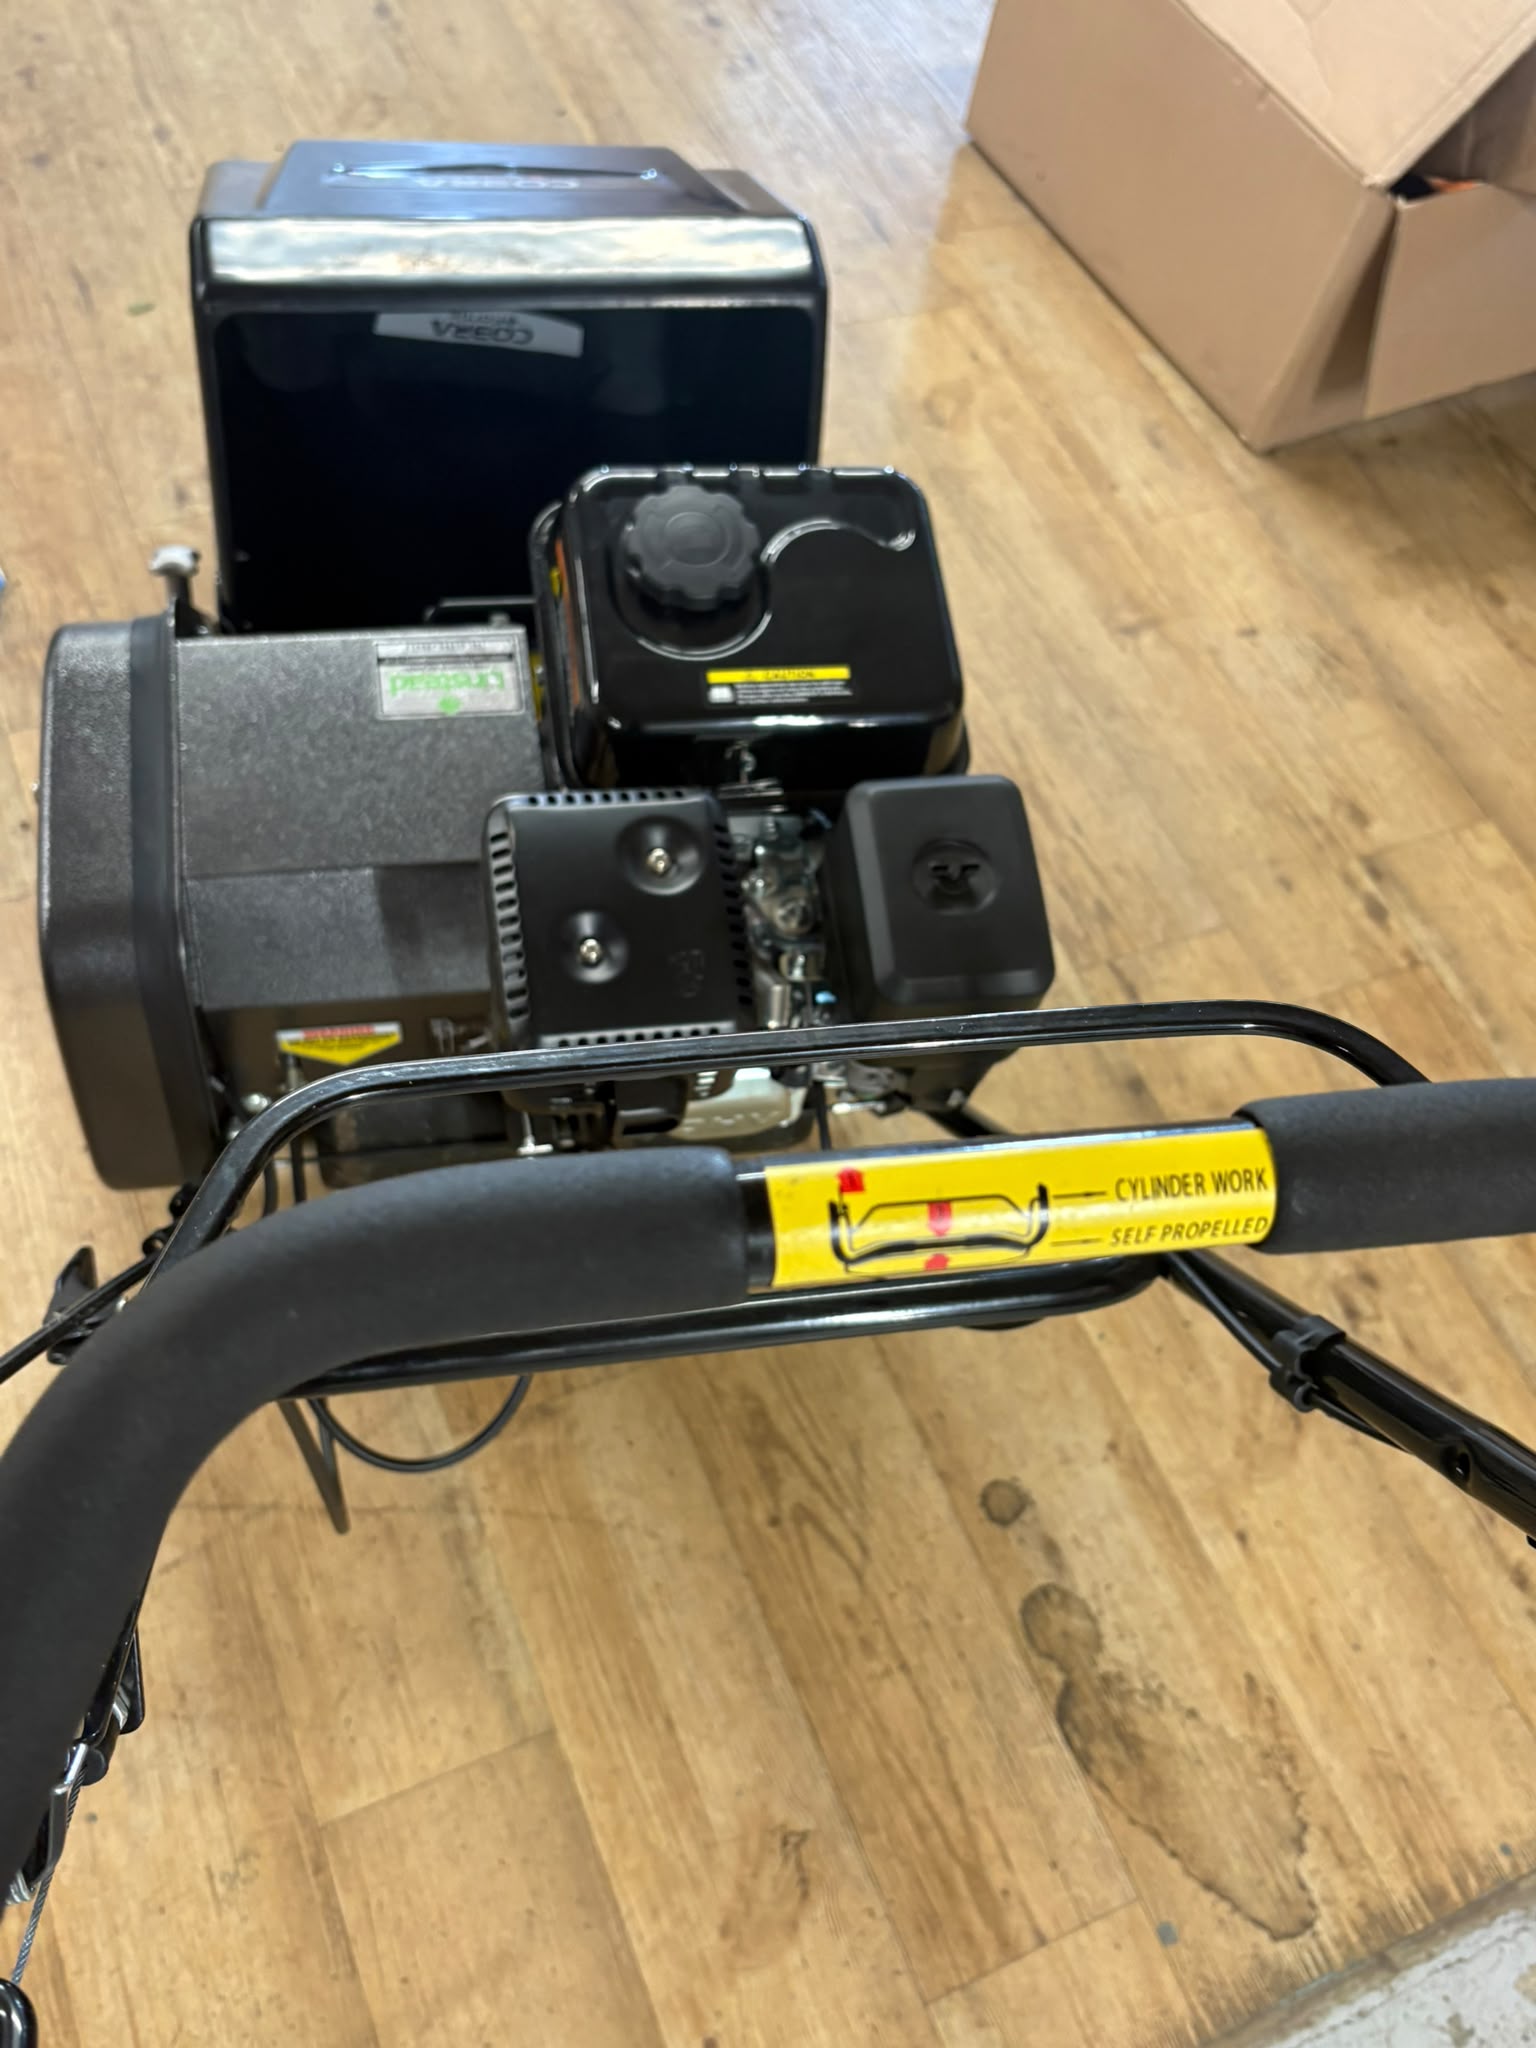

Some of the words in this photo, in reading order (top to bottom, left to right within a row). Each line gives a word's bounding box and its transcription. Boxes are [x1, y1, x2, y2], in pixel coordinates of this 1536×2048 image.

[431, 319, 535, 345] COBRA
[1115, 1172, 1205, 1202] CYLINDER
[1211, 1168, 1268, 1194] WORK
[1111, 1225, 1156, 1246] SELF
[1160, 1216, 1269, 1241] PROPELLED
